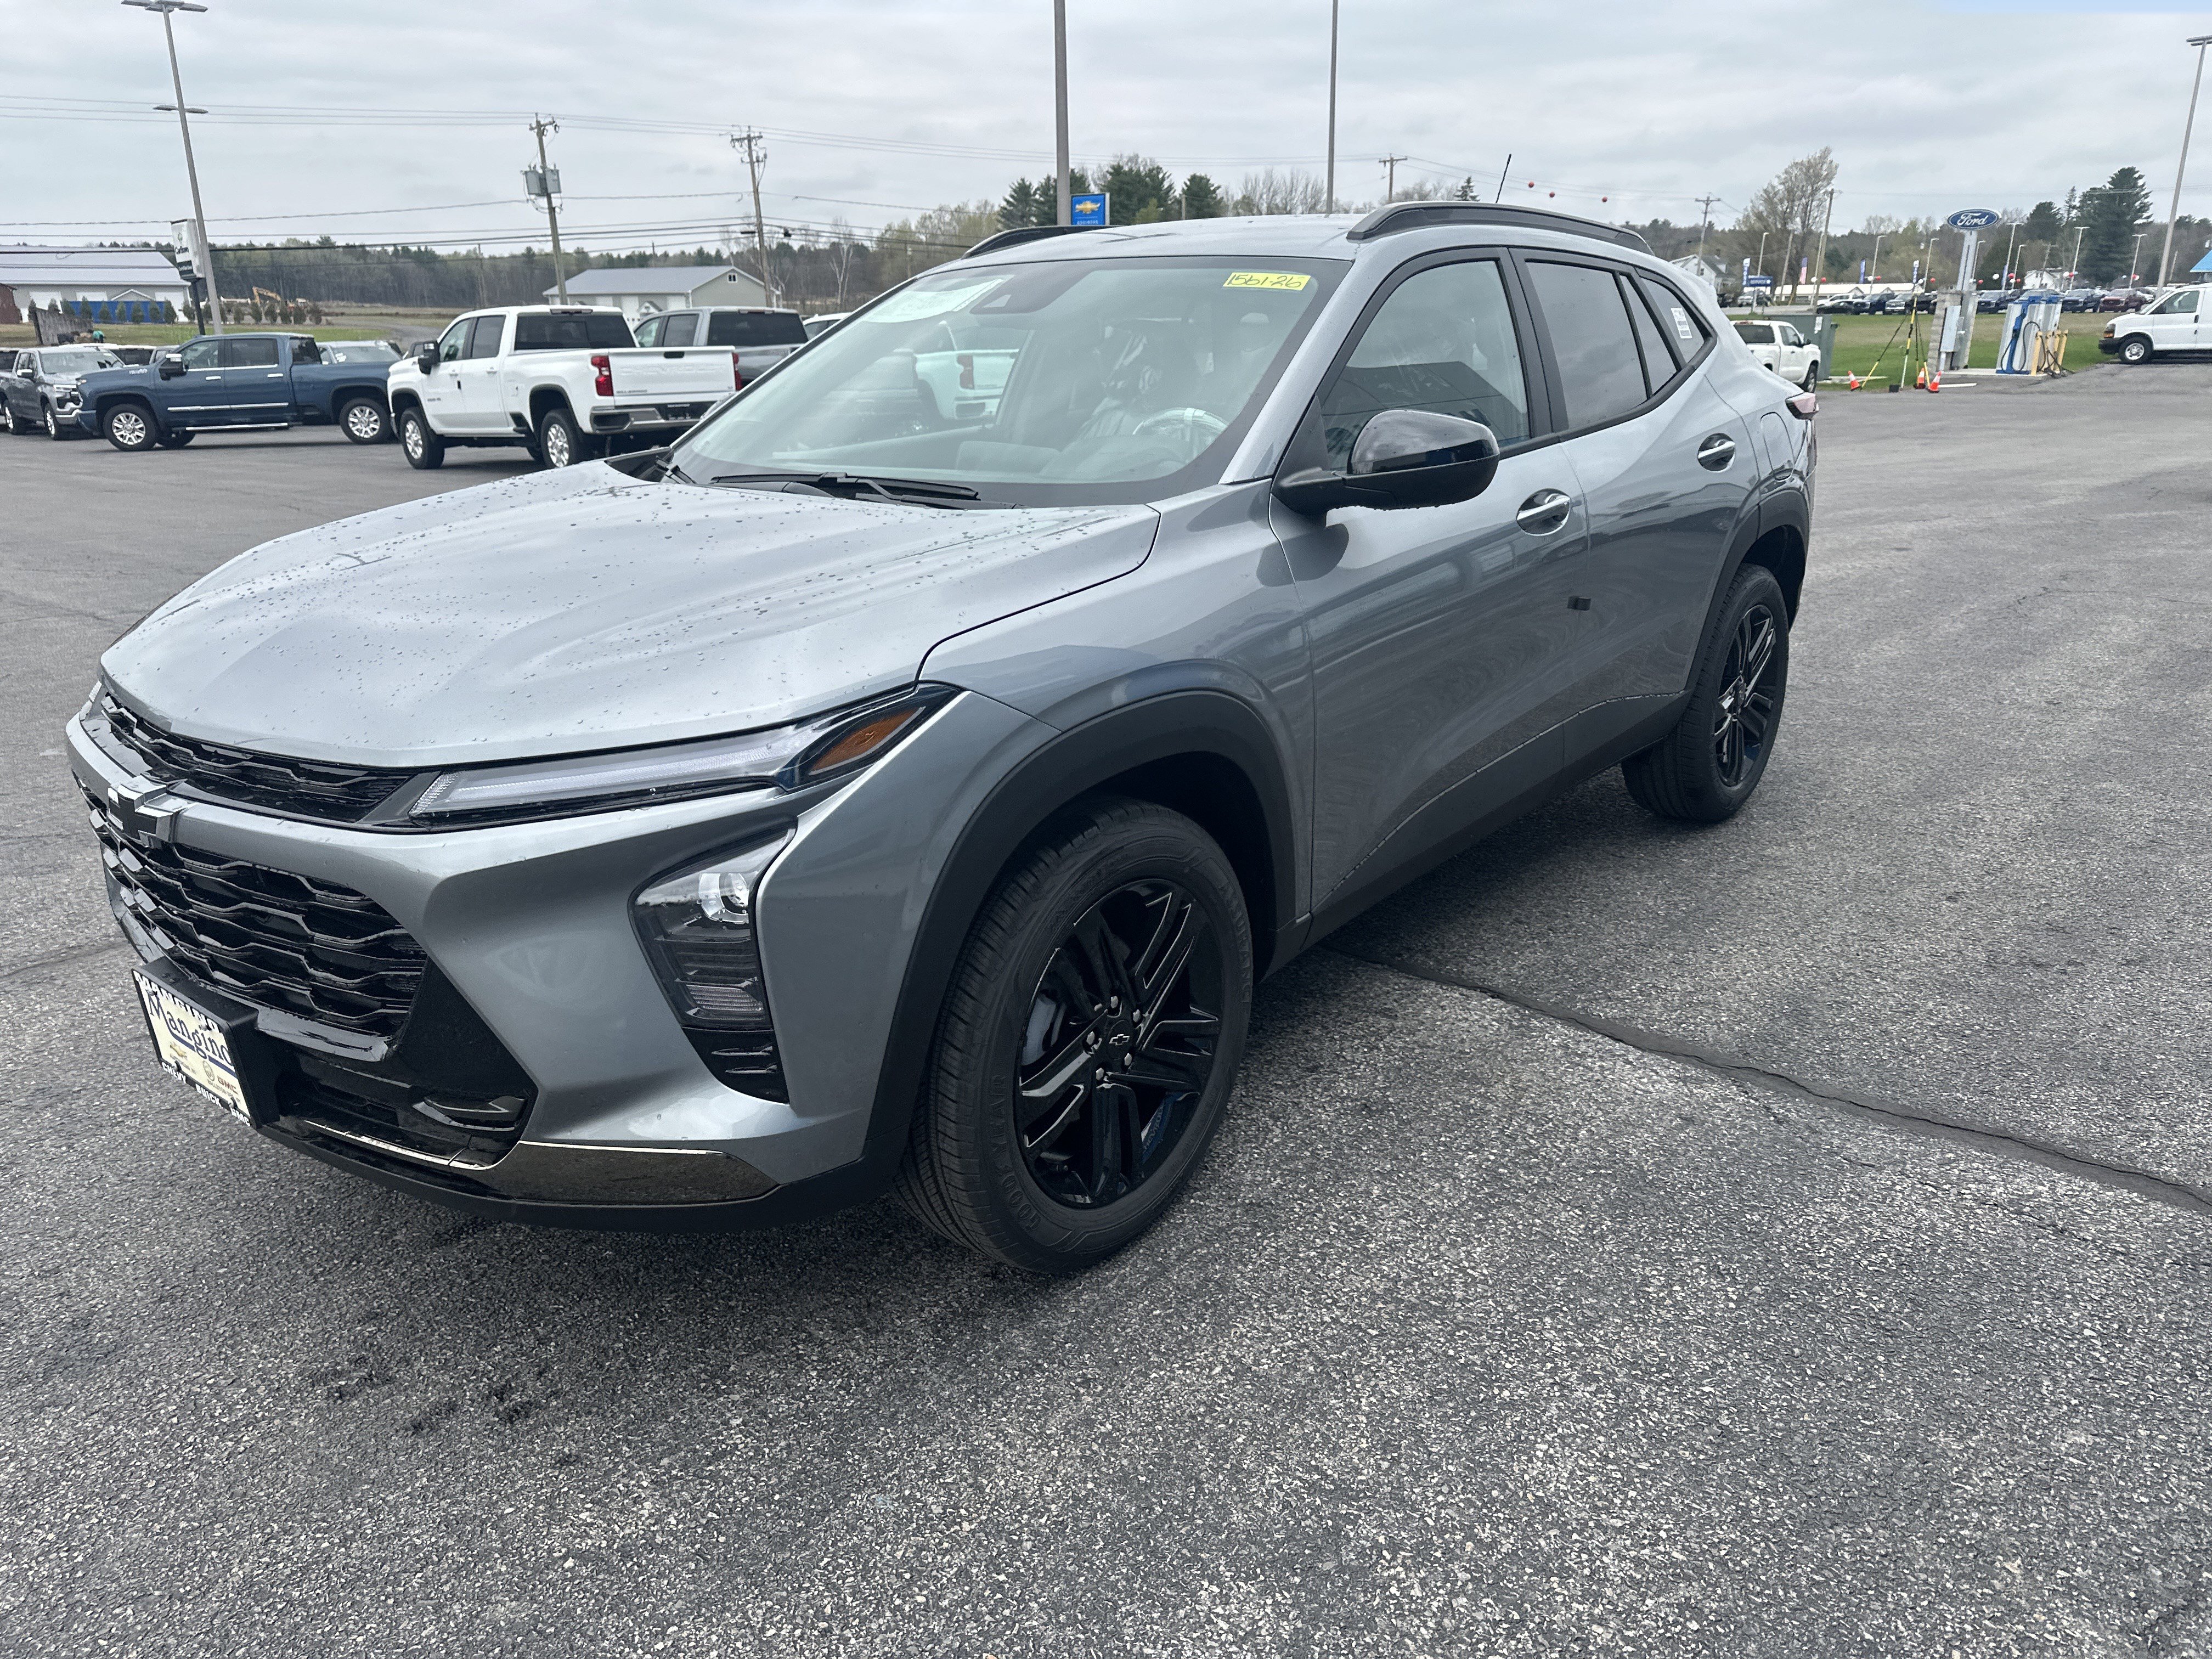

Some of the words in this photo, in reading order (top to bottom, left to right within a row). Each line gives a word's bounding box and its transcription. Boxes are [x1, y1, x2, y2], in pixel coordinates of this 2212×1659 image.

[1957, 212, 1989, 226] Ford
[133, 970, 221, 1033] MANGINO
[146, 989, 233, 1066] Mangino
[195, 1084, 222, 1108] BUICK
[230, 1107, 251, 1127] GMC
[217, 1075, 239, 1096] GMC
